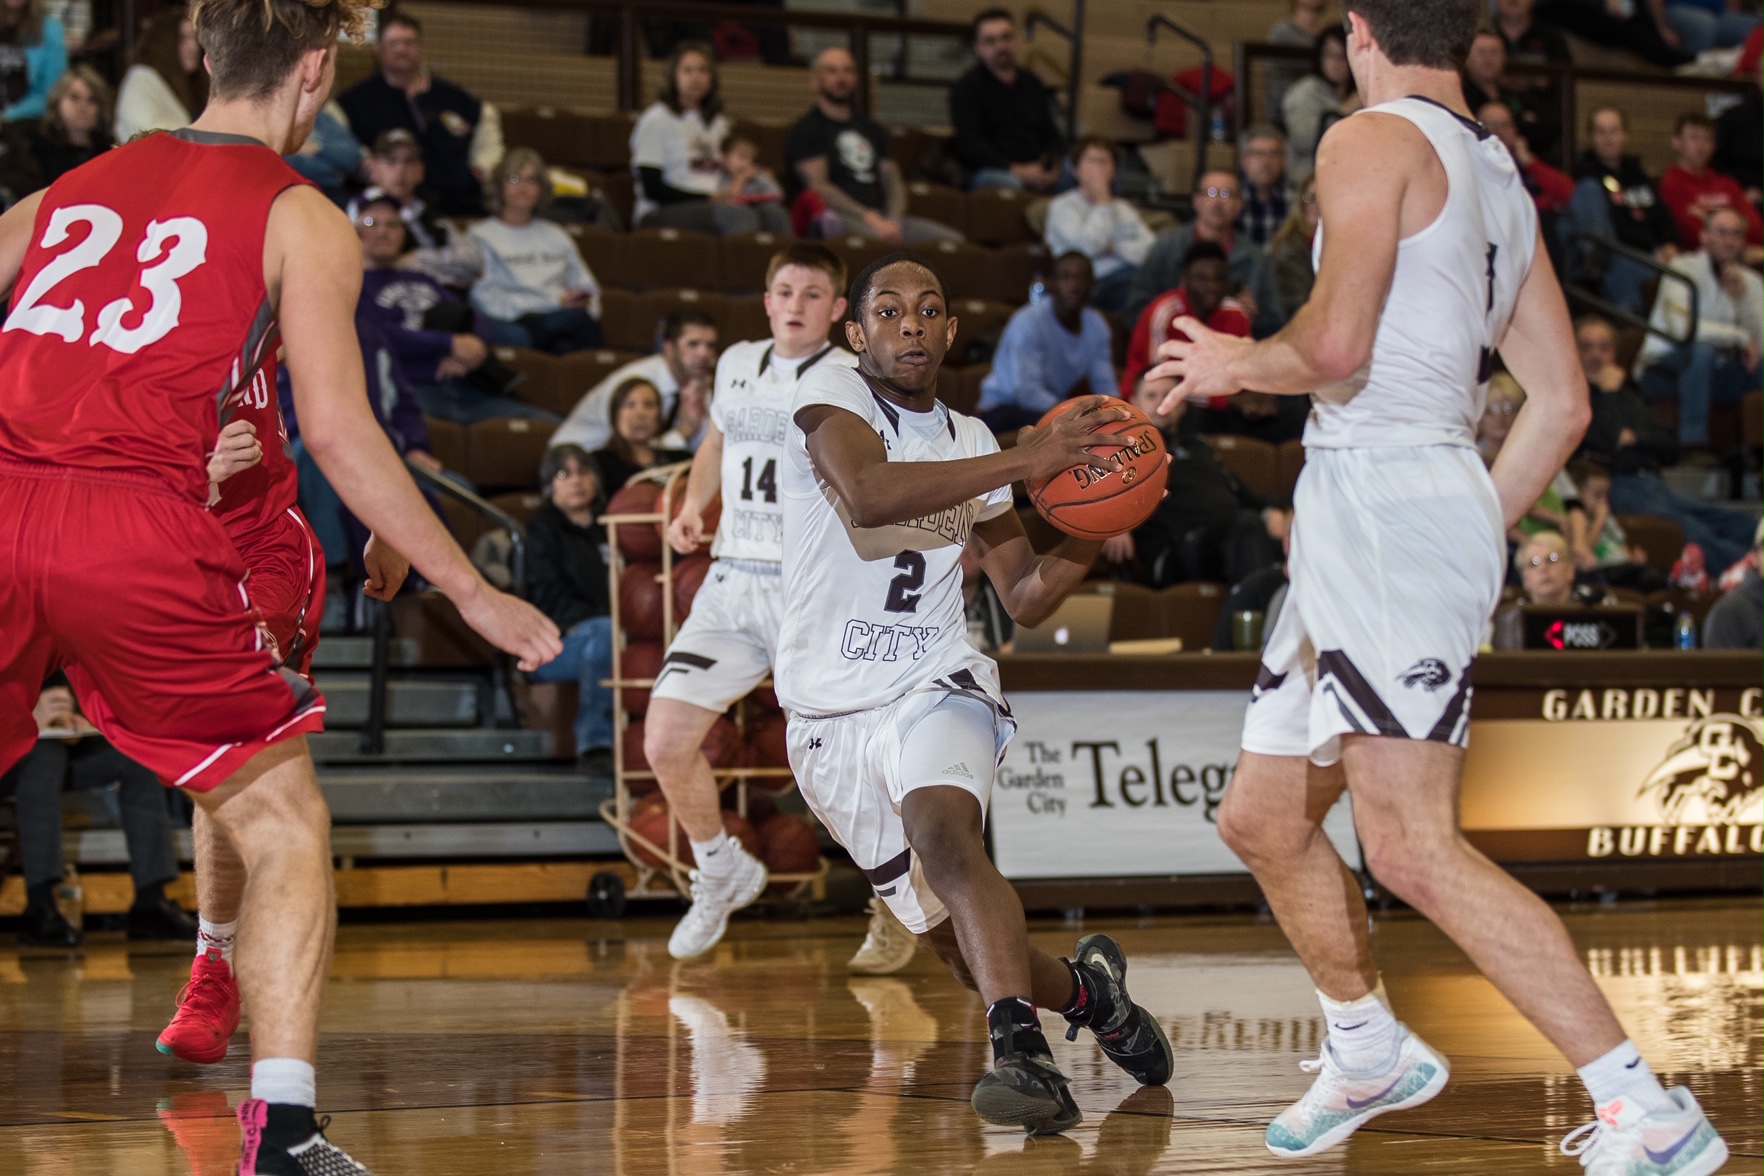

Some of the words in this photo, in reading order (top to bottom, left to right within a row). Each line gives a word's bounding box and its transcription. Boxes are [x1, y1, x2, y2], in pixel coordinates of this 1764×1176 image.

[2, 203, 208, 354] 23
[741, 456, 778, 504] 14
[884, 549, 927, 613] 2
[841, 619, 940, 662] CITY
[1563, 623, 1600, 648] POSS
[1542, 688, 1715, 721] GARDEN
[1024, 740, 1062, 764] The
[942, 769, 974, 780] adidas
[997, 767, 1065, 791] Garden
[1071, 737, 1237, 825] Teleg
[1026, 792, 1067, 818] City
